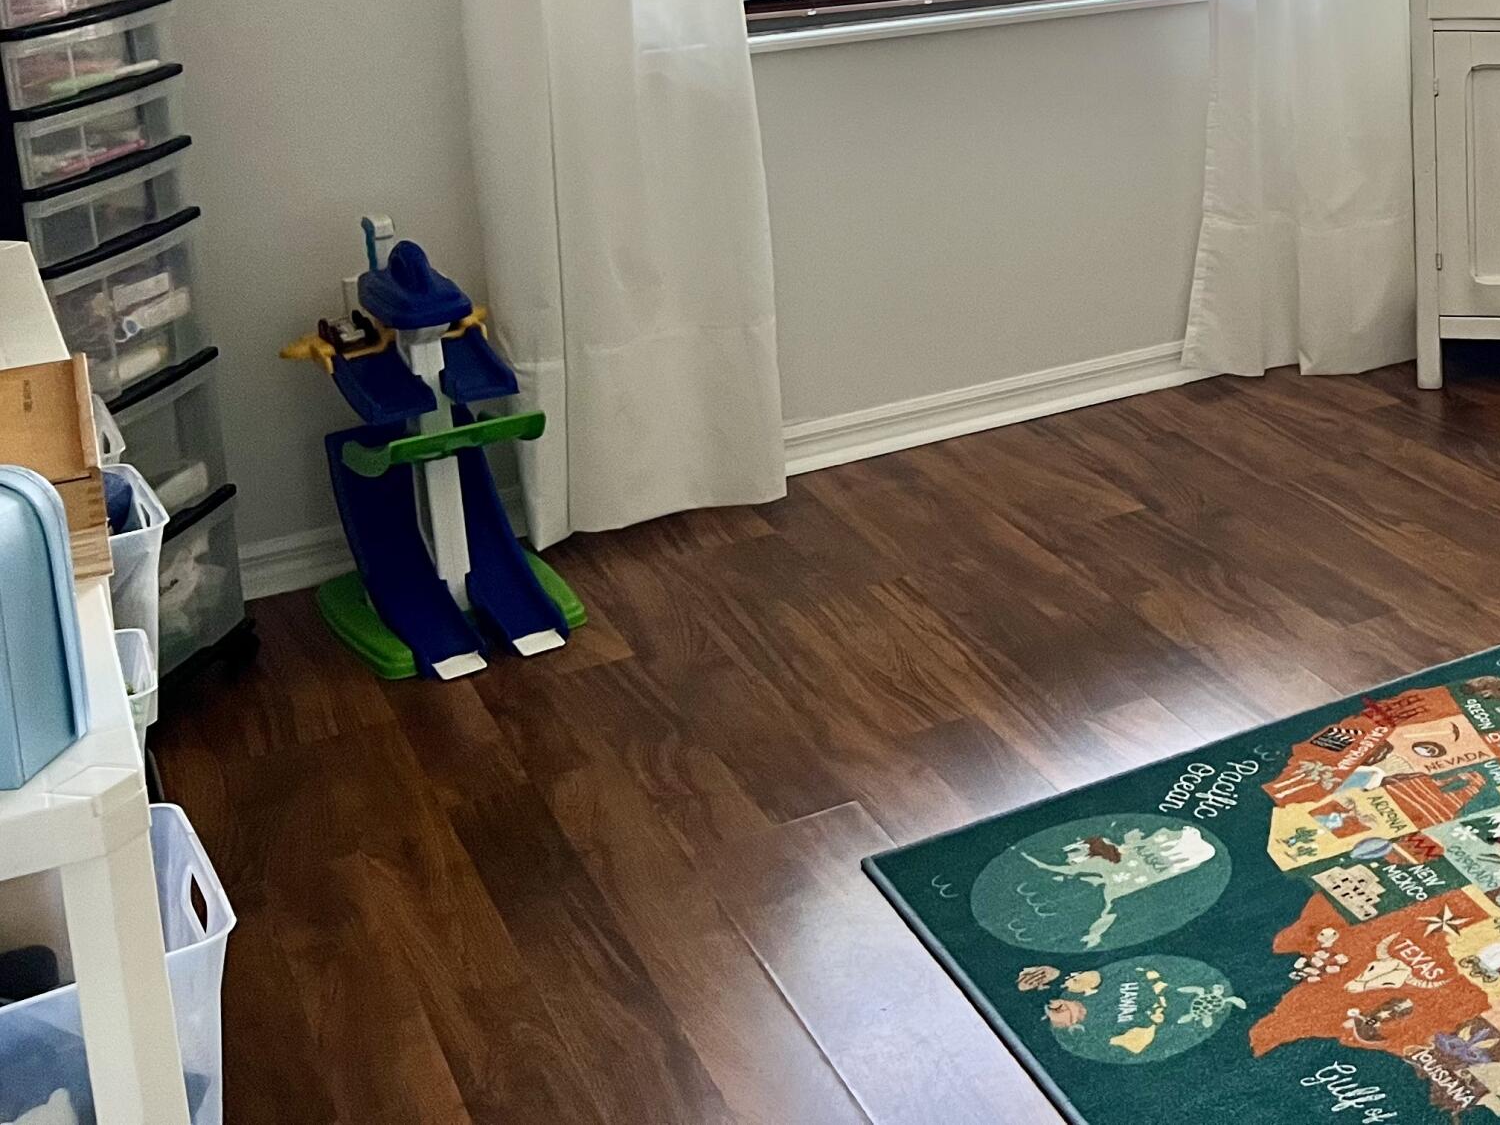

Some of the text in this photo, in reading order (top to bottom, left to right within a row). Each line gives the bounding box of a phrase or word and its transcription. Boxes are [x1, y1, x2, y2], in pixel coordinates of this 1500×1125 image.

[1464, 698, 1497, 731] OREGON
[1424, 750, 1491, 772] NEVADA
[1159, 763, 1216, 812] Ocean
[1194, 760, 1259, 819] Pacific
[1368, 794, 1408, 833] ARIZONA
[1382, 864, 1428, 901] MEXICO
[1408, 863, 1446, 887] NEW
[1393, 938, 1444, 981] TEXAS
[1300, 1061, 1386, 1112] Gulf
[1411, 1048, 1476, 1108] LOUISIANA
